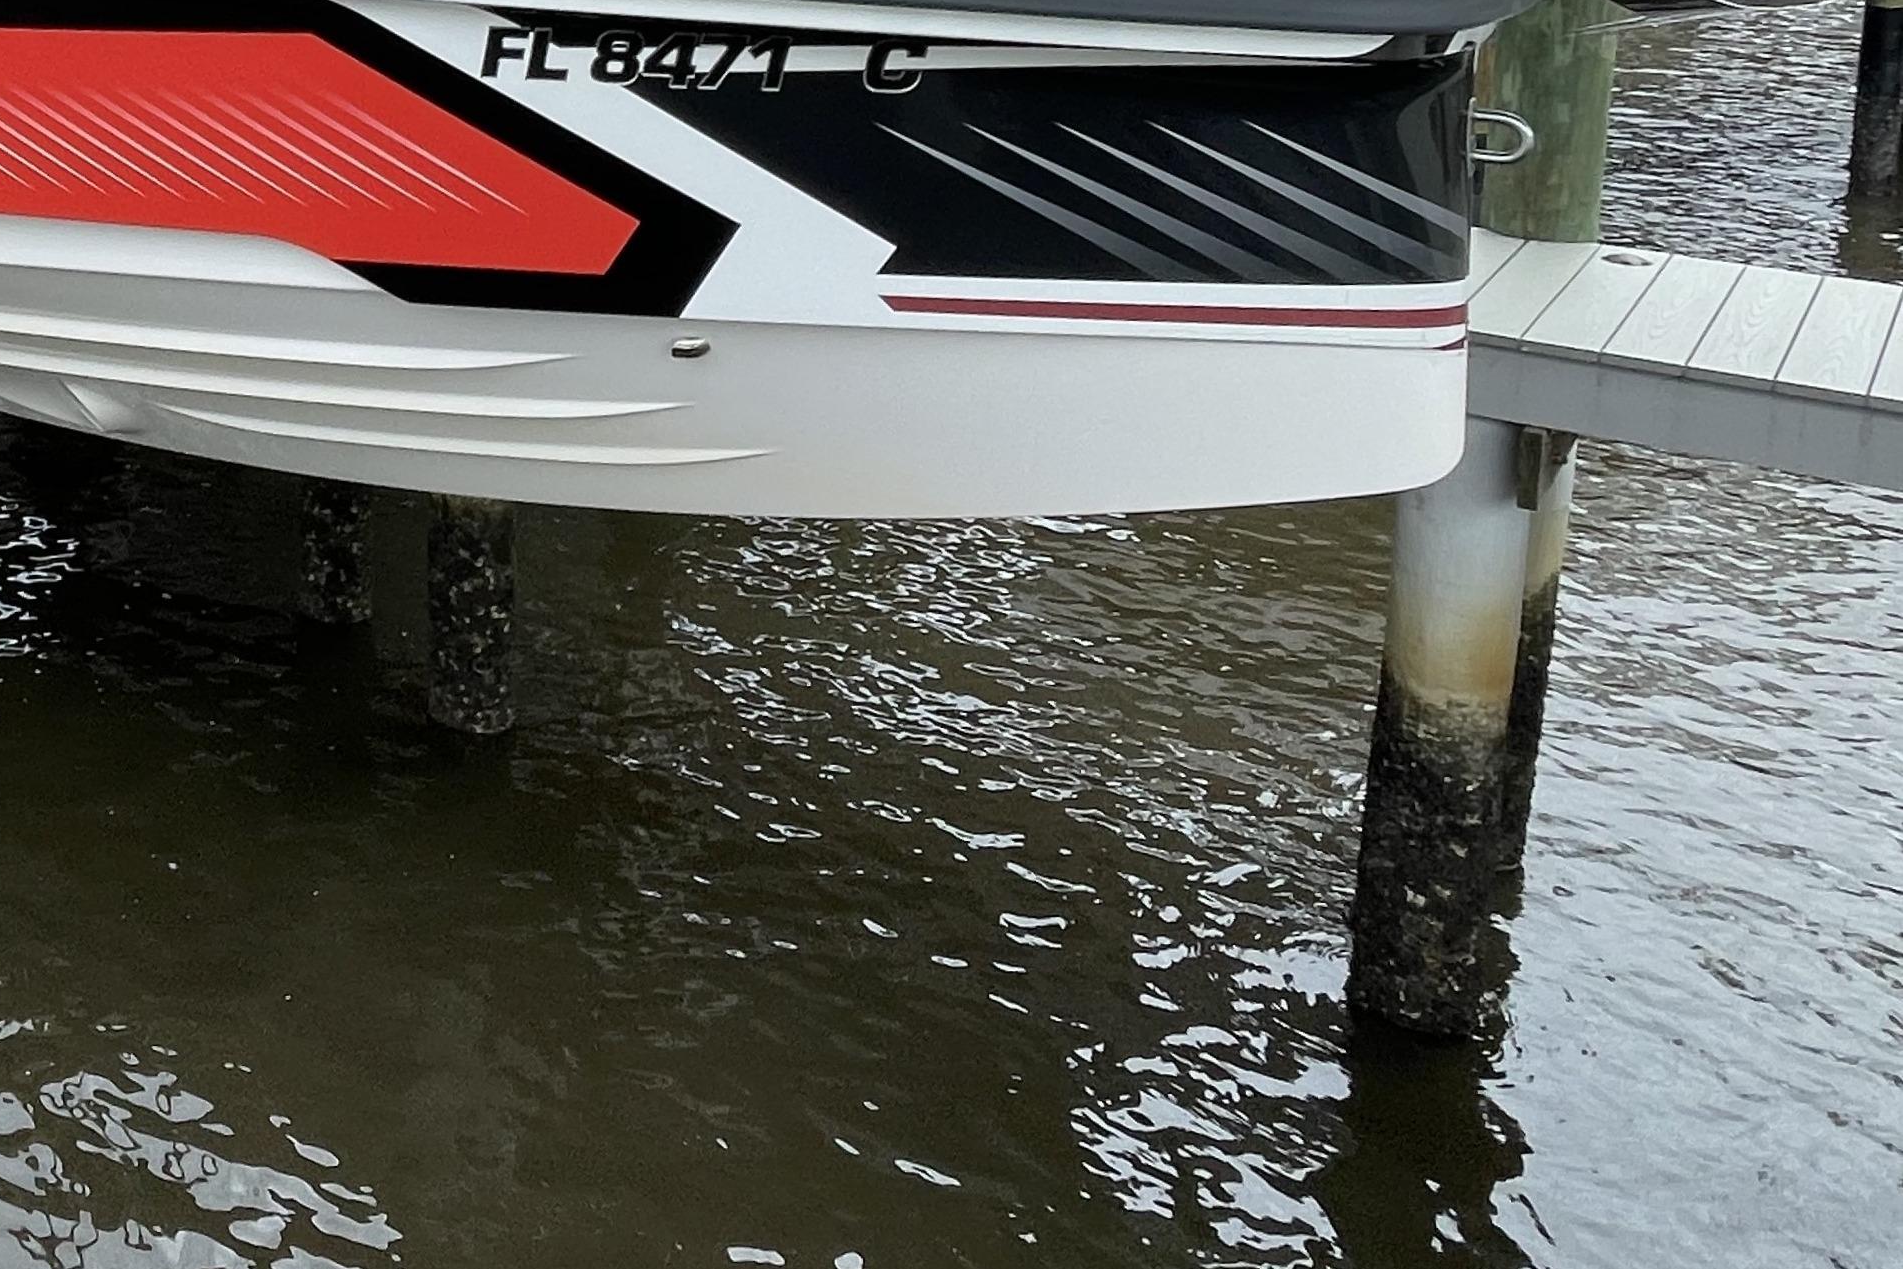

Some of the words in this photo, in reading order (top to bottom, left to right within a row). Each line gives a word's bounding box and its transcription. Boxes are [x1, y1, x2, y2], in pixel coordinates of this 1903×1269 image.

[480, 25, 568, 82] FL
[590, 29, 793, 93] 8471
[863, 39, 929, 94] C
